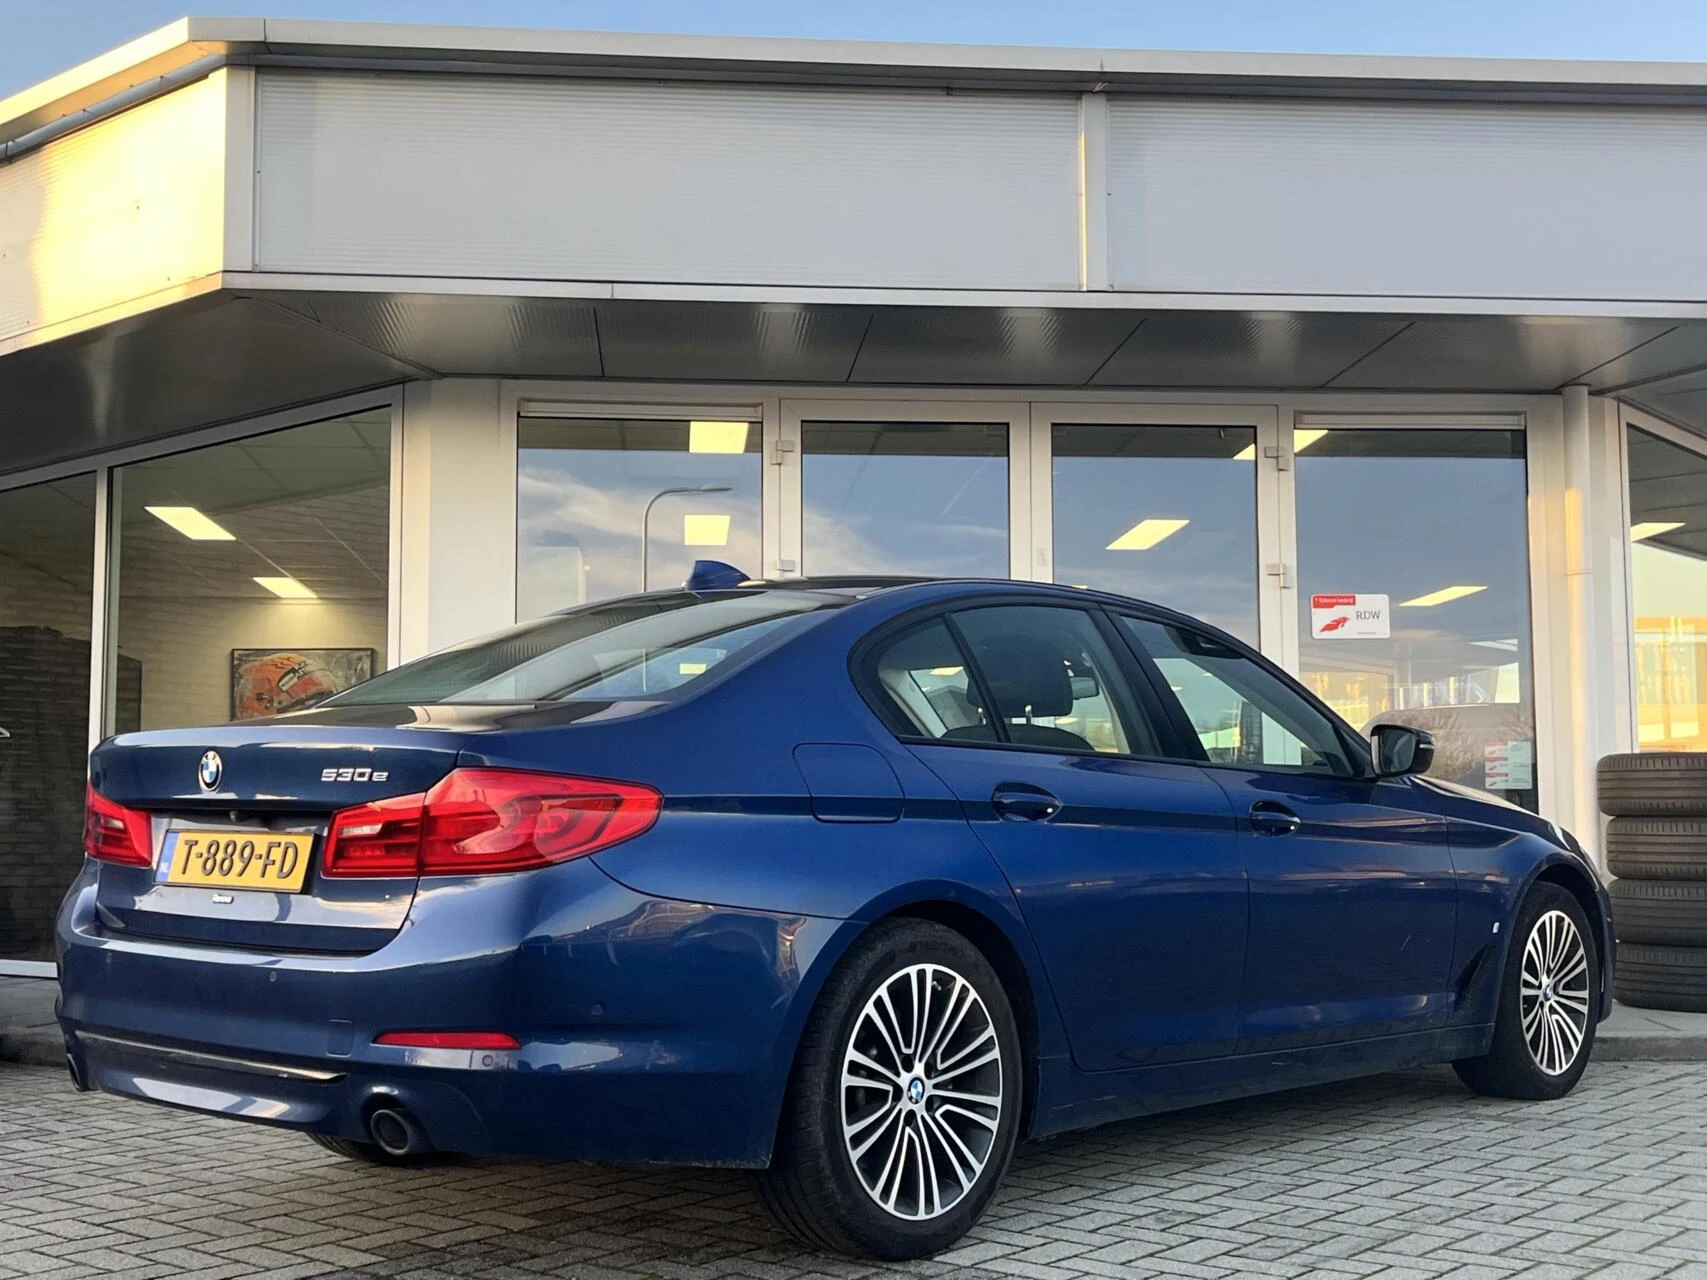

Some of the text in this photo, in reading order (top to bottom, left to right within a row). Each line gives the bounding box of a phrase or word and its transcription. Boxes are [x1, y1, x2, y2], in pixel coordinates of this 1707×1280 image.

[1356, 610, 1381, 620] RDW
[320, 768, 389, 782] 530e
[181, 839, 299, 879] T-889-FD
